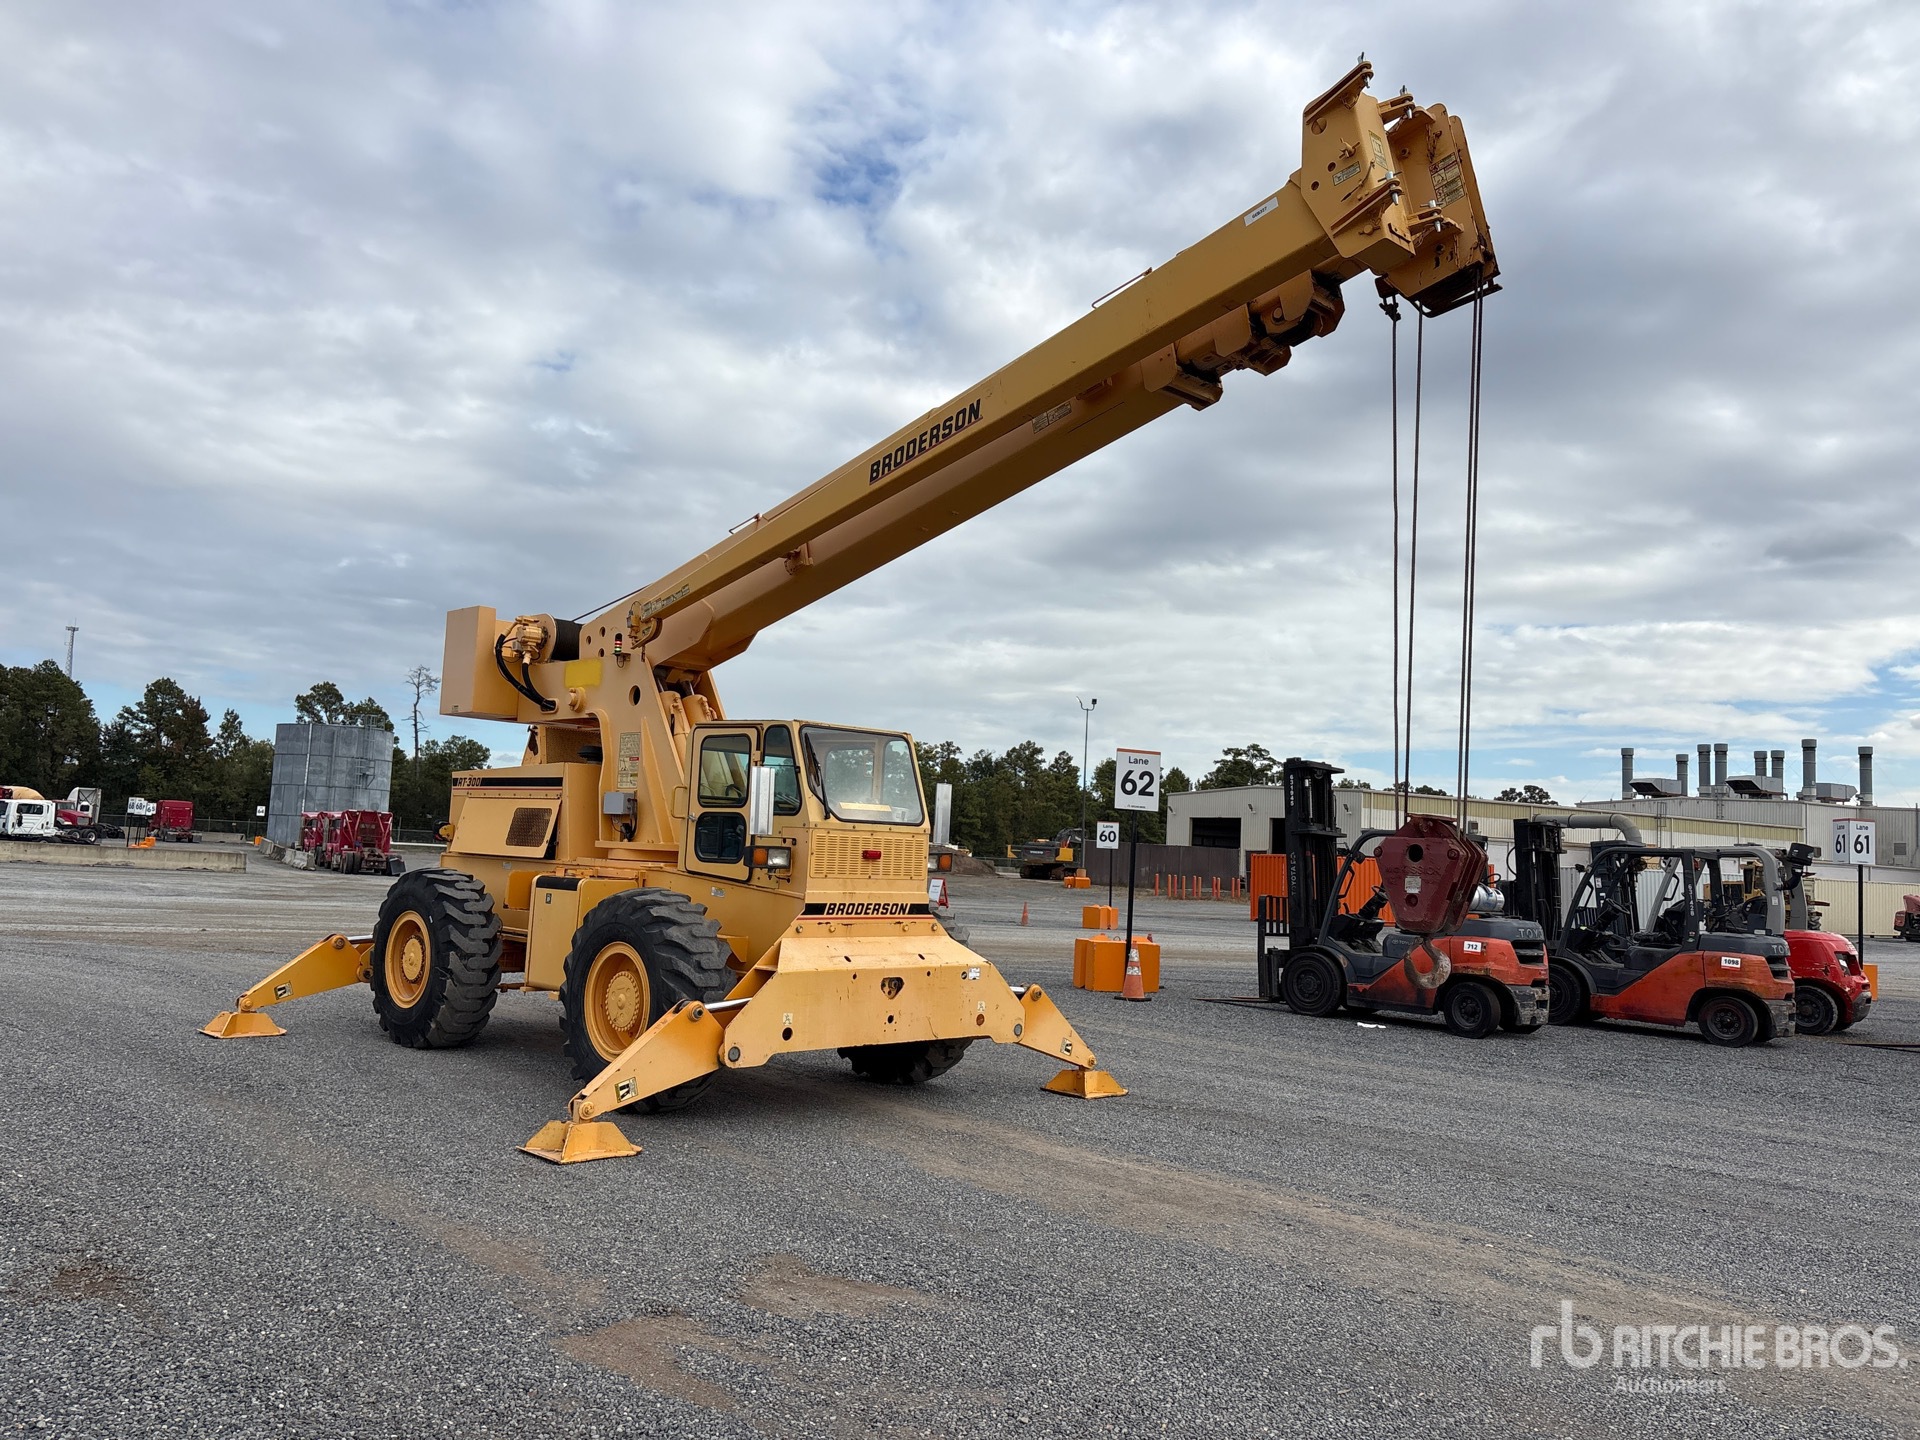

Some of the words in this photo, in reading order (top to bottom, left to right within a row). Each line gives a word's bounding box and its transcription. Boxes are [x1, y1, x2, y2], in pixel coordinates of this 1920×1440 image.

[869, 398, 982, 483] BRODERSON
[1128, 755, 1150, 766] Lane
[457, 777, 481, 787] RT-300
[1120, 769, 1155, 797] 62
[1855, 823, 1869, 831] Lane
[1098, 830, 1117, 843] 60
[1835, 833, 1846, 854] 61
[1853, 834, 1870, 854] 61
[826, 902, 909, 916] BRODERSON
[1724, 958, 1739, 966] 1098
